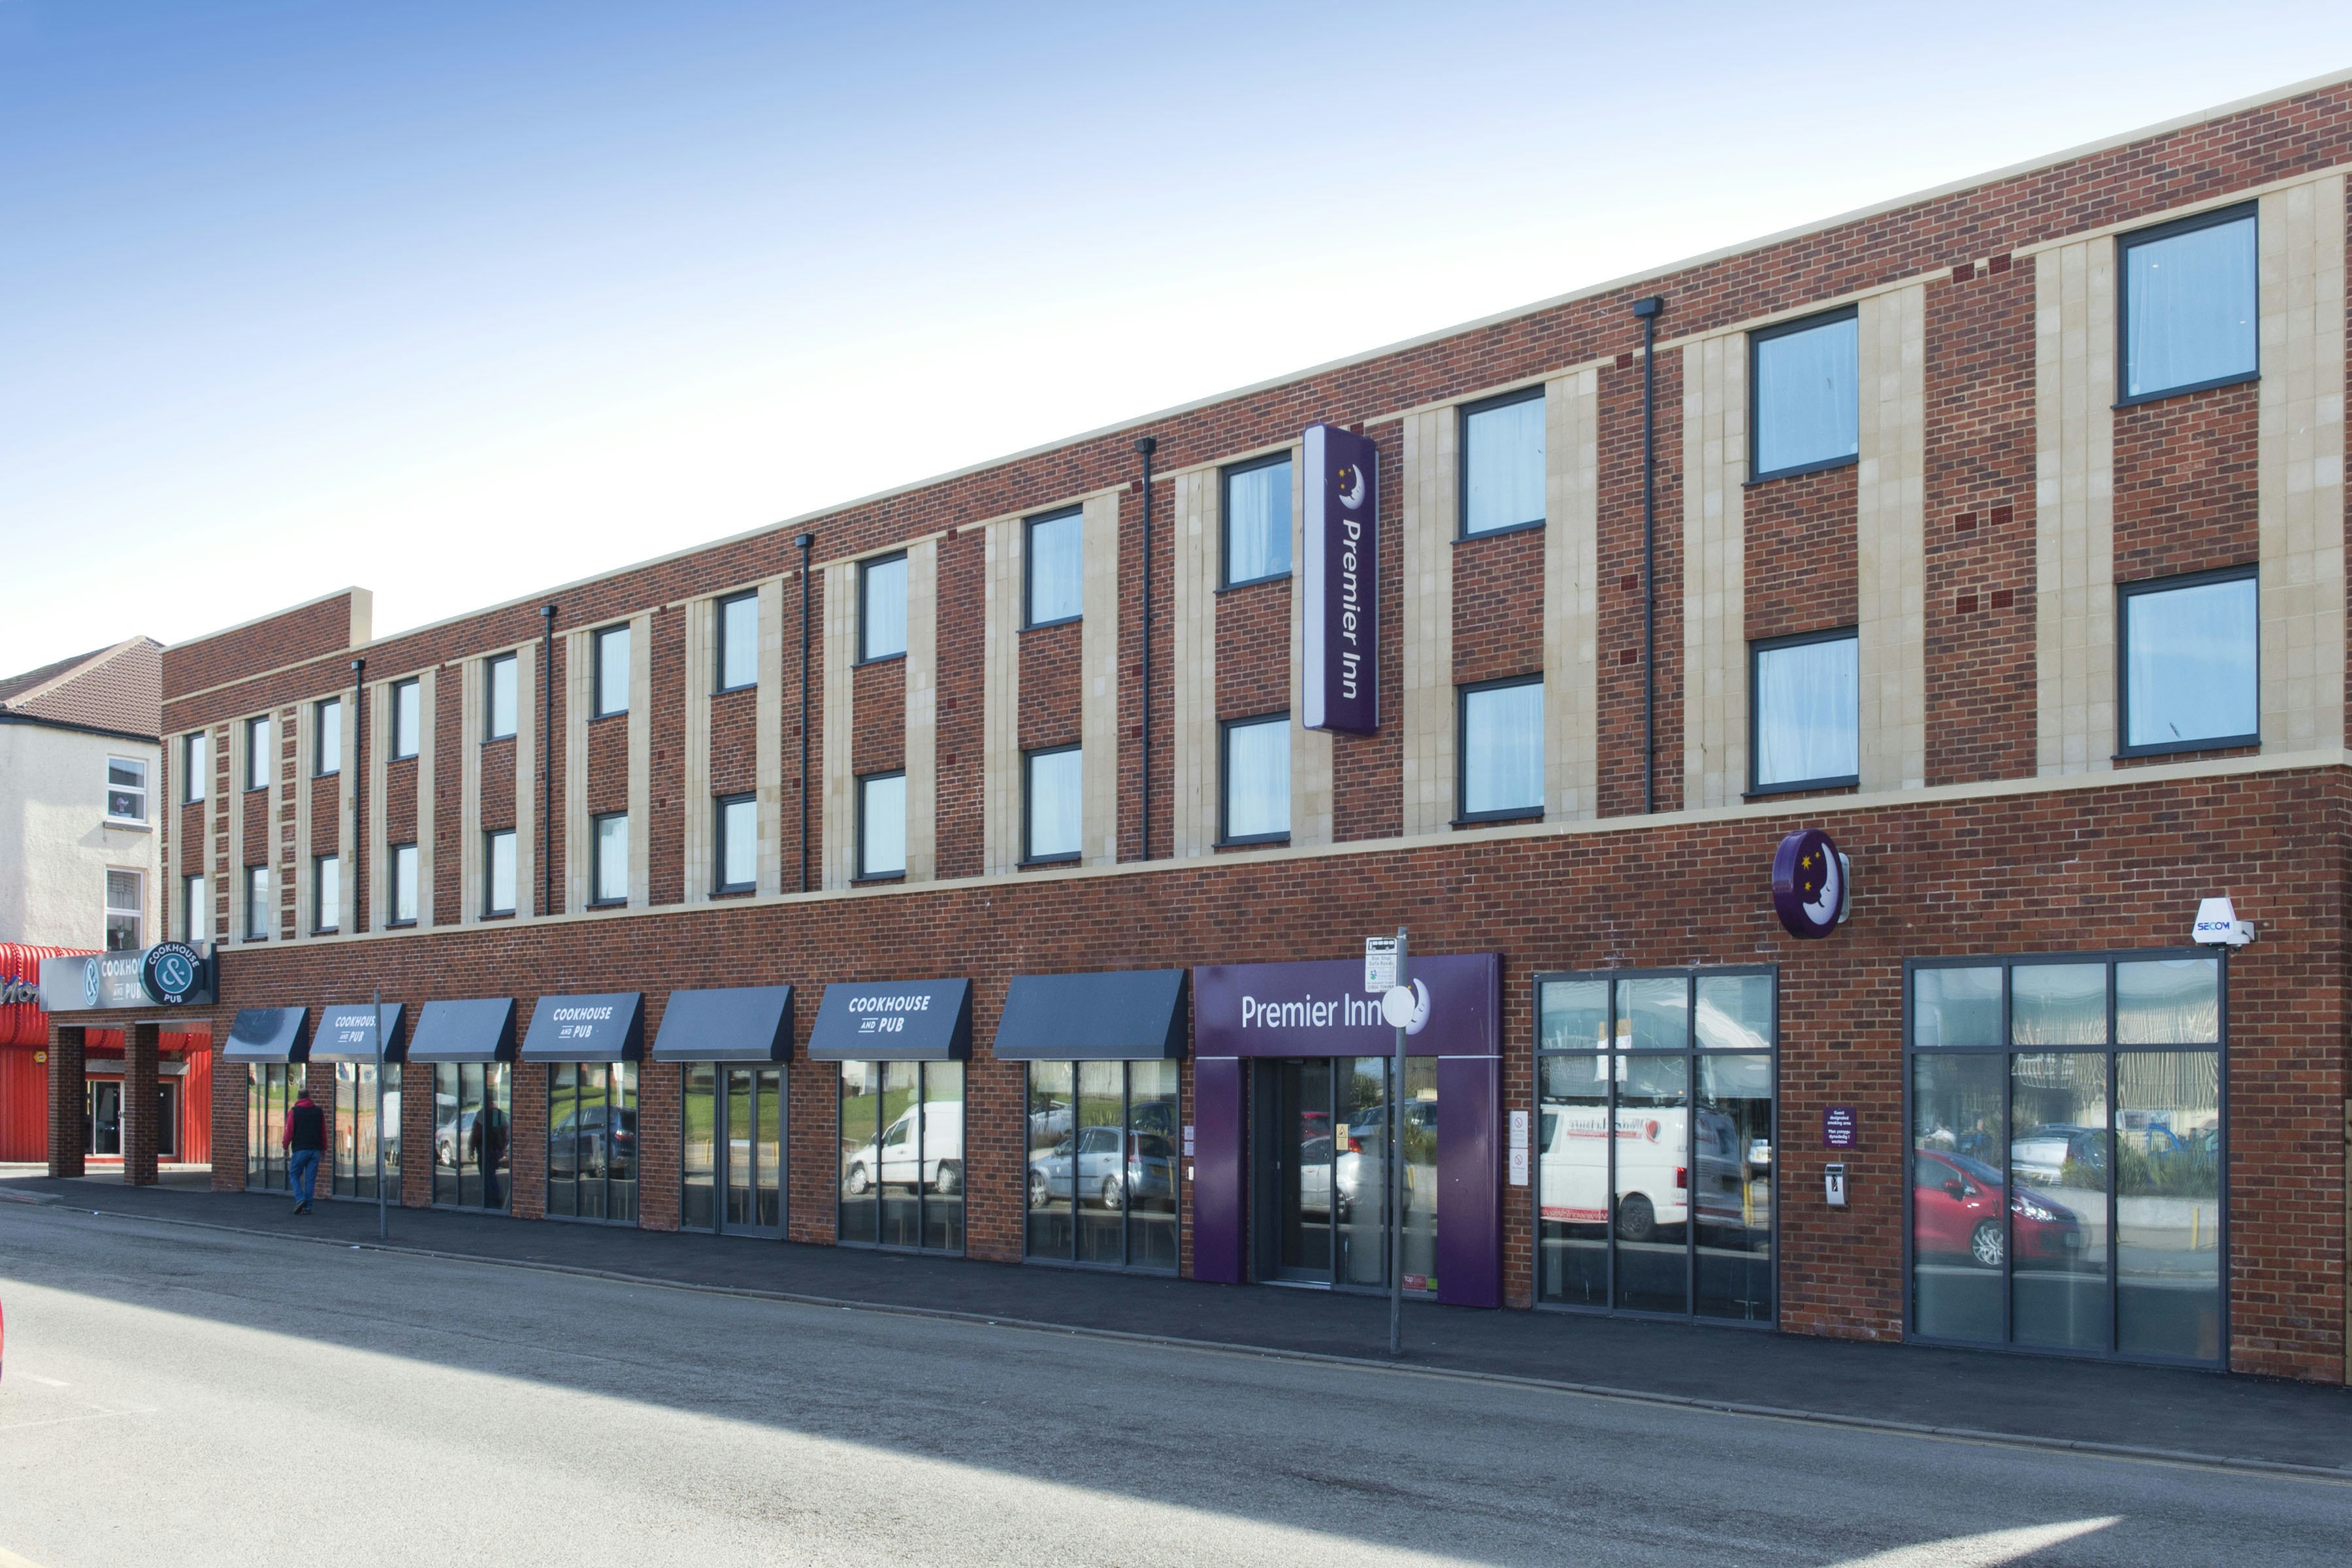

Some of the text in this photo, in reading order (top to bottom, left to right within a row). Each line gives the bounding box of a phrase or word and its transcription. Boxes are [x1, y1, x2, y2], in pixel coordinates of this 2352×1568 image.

[1343, 519, 1361, 700] Premier Inn
[2197, 922, 2230, 931] SECOM
[149, 943, 200, 968] COOKHOUSE
[101, 958, 140, 977] COOKHO
[125, 982, 141, 1000] PUB
[164, 994, 182, 1004] PUB
[849, 995, 931, 1013] COOKHOUSE
[553, 1006, 613, 1021] COOKHOUSE
[1242, 992, 1382, 1028] Premier Inn
[335, 1015, 376, 1028] COOKHOUS
[860, 1017, 905, 1032] AND PUB
[348, 1030, 365, 1042] PUB
[572, 1024, 593, 1038] PUB
